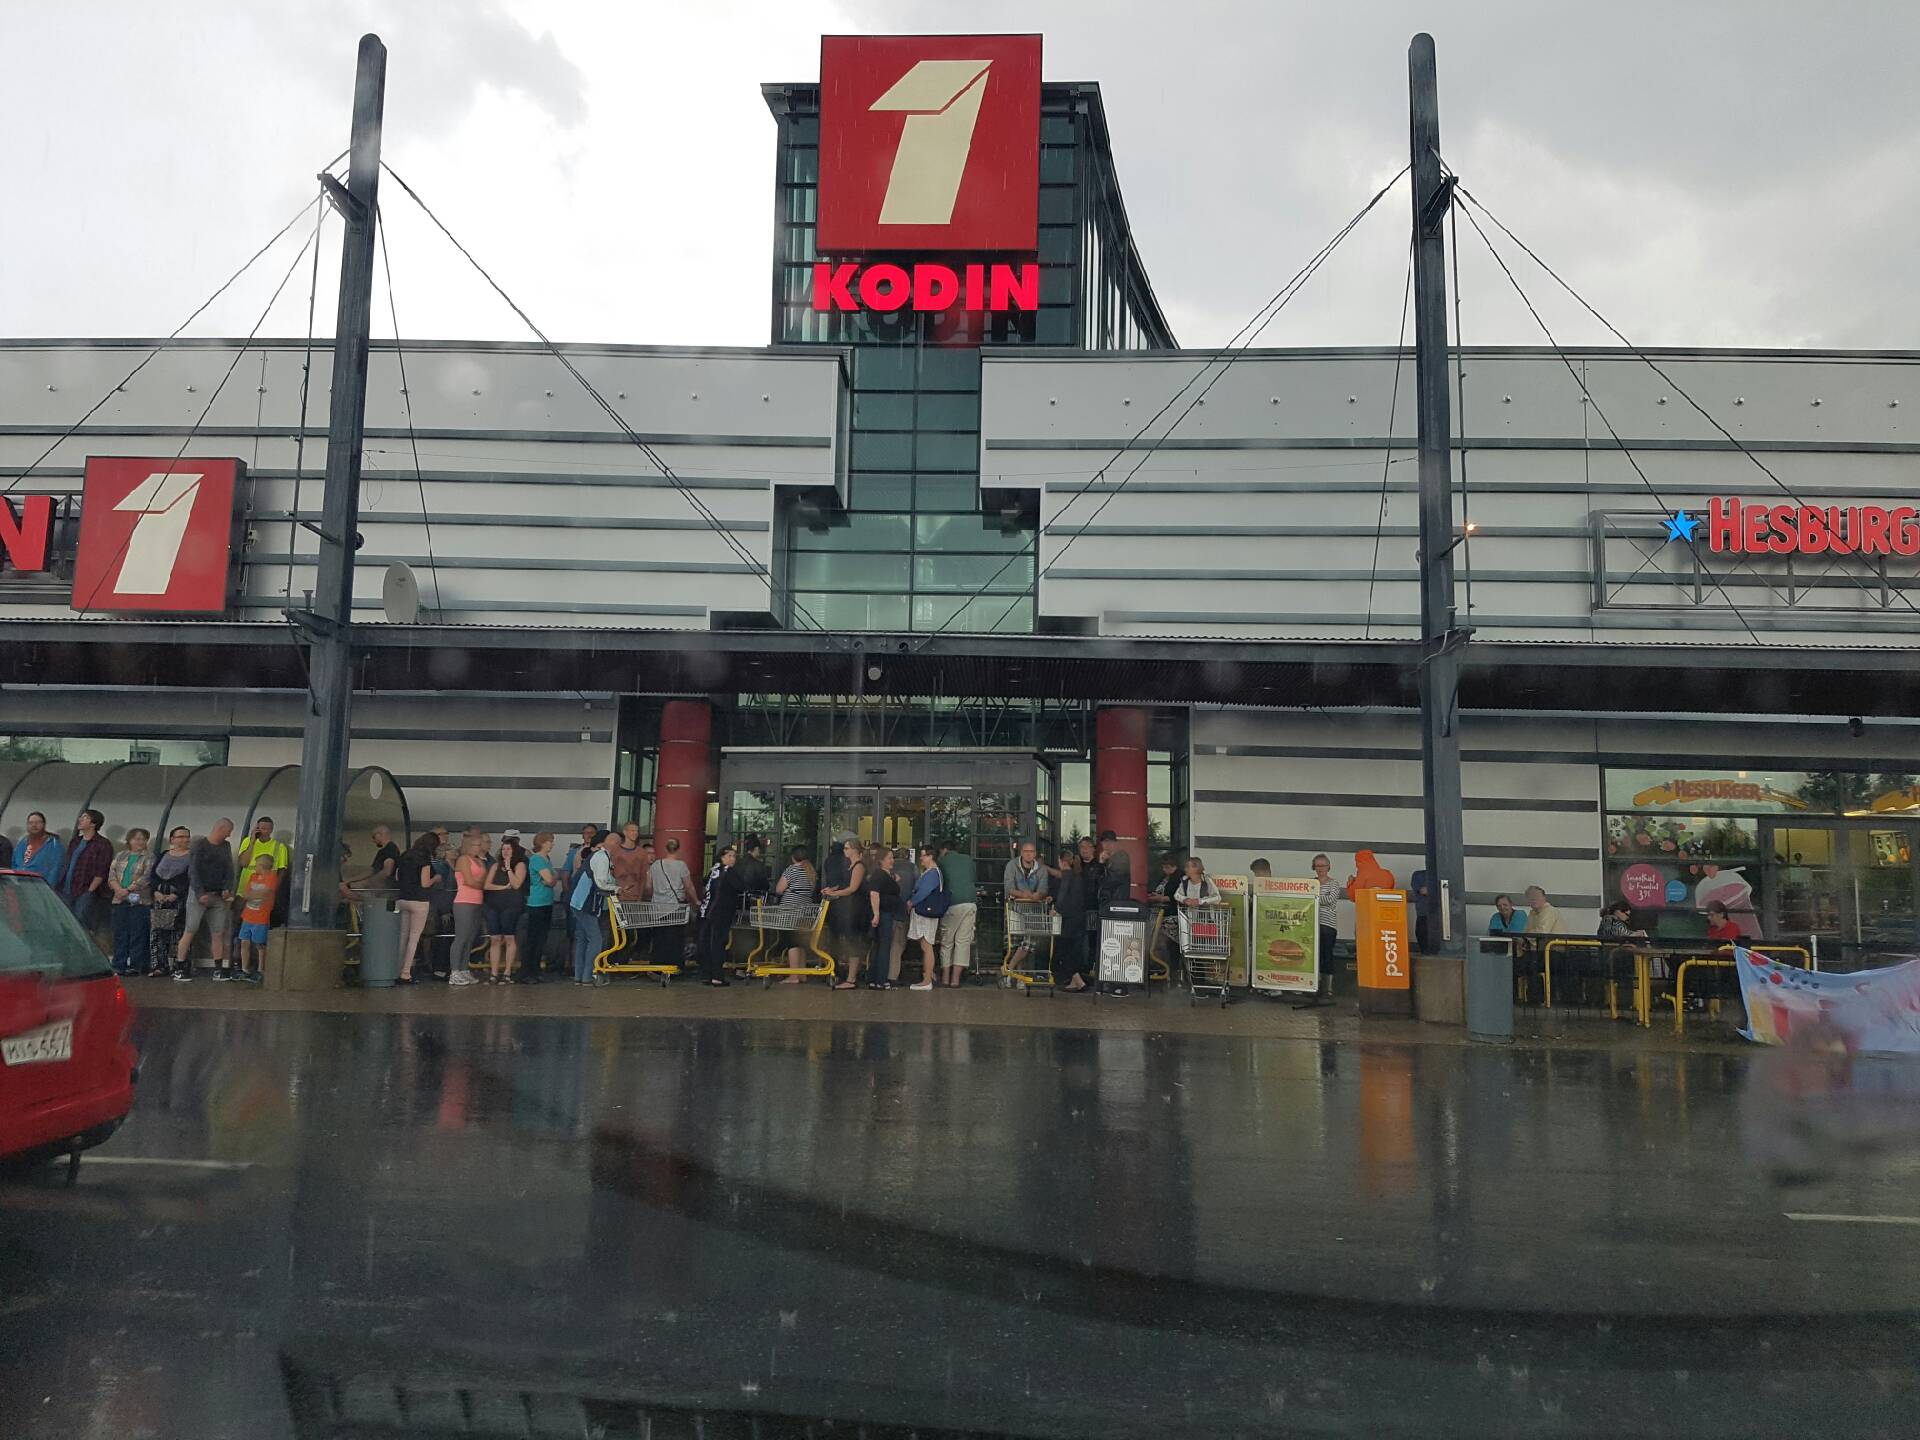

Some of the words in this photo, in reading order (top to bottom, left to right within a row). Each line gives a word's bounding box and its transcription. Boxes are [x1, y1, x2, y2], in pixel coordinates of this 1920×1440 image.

[868, 59, 994, 225] 1
[813, 263, 1039, 311] KODIN
[112, 473, 205, 594] 1
[1673, 779, 1762, 801] HESBURGER
[1214, 879, 1238, 889] URGER
[1264, 879, 1310, 892] HESBURGER
[1380, 930, 1404, 977] posti
